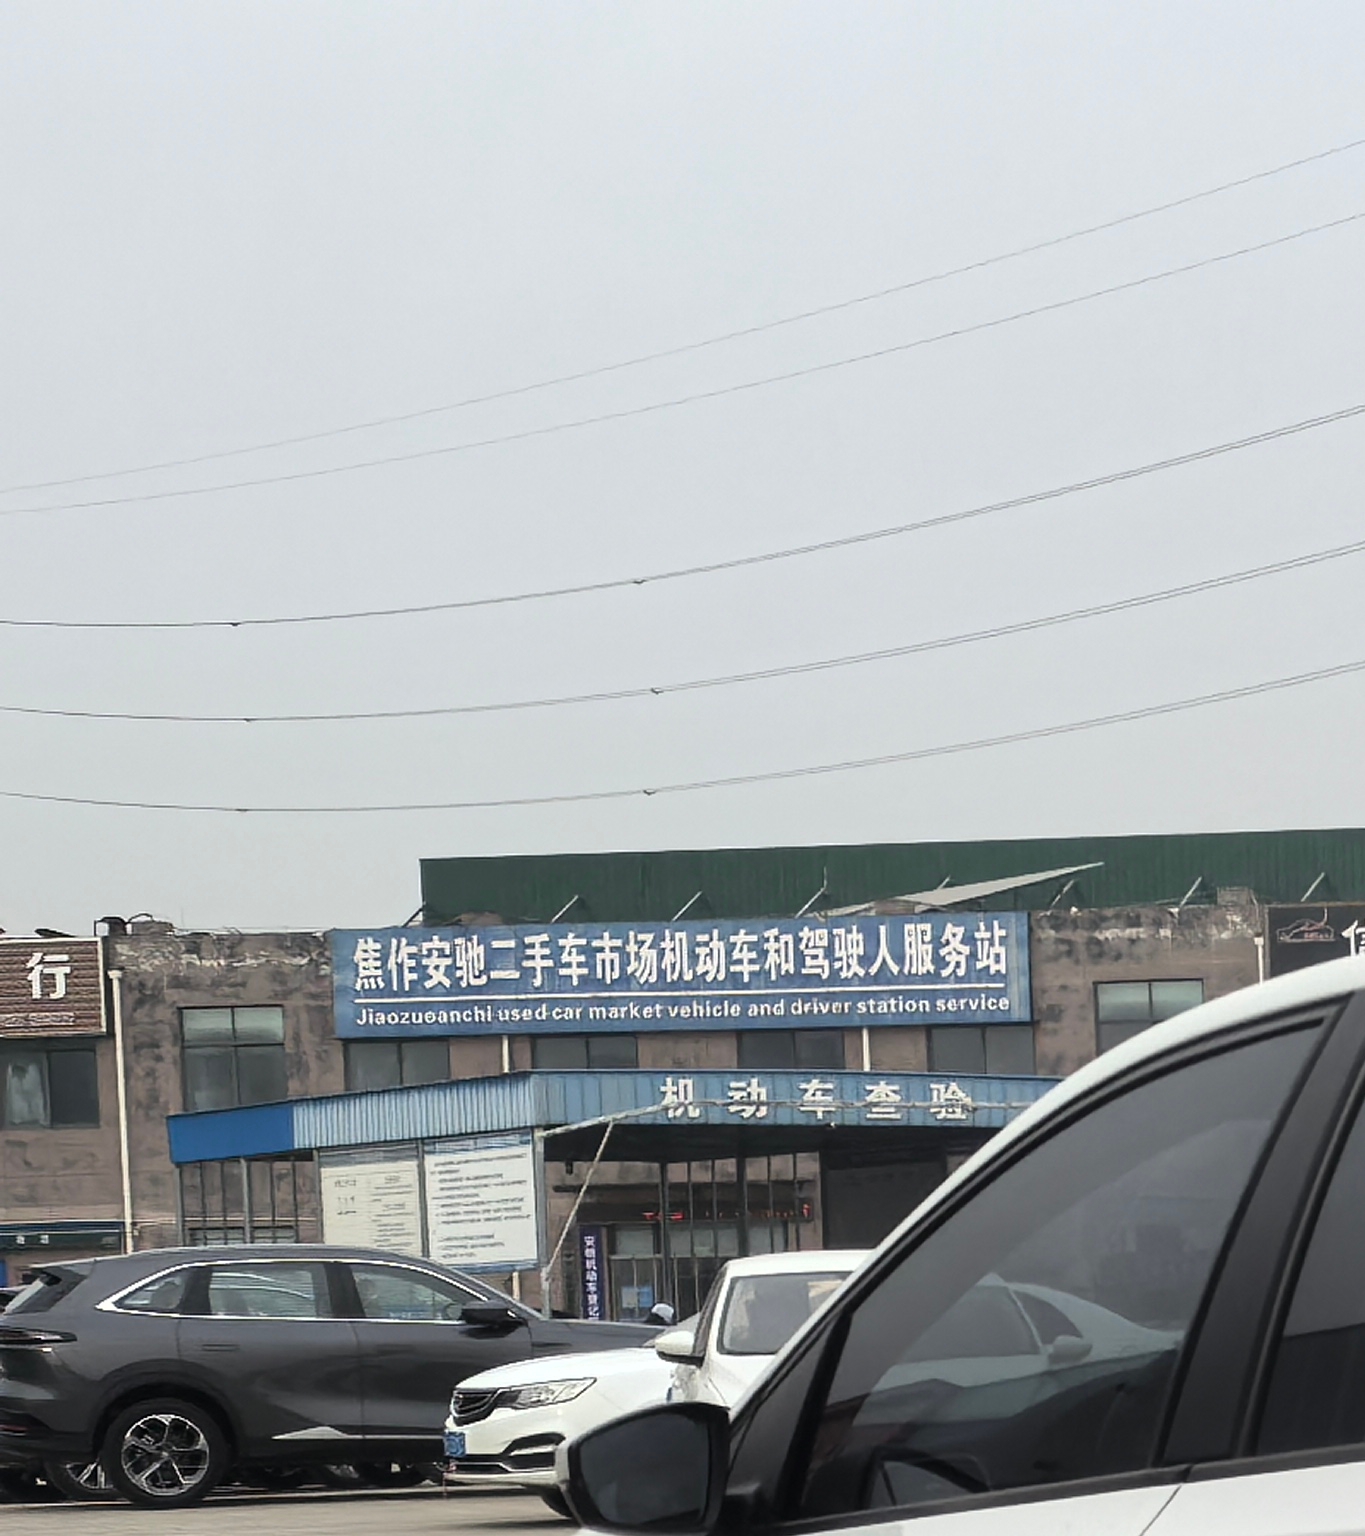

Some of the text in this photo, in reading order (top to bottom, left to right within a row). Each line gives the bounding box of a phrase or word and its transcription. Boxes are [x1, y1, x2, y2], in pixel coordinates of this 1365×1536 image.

[25, 952, 72, 1000] 行
[353, 920, 1008, 992] 焦作安驰二手车市场机动车和驾驶人服务站
[498, 1003, 547, 1023] used
[552, 1004, 584, 1022] car
[588, 1001, 664, 1021] market
[667, 998, 741, 1019] vehicle
[748, 998, 785, 1017] and
[790, 996, 852, 1015] driver
[857, 995, 931, 1014] station
[936, 993, 1010, 1013] service
[659, 1076, 972, 1121] 机动车查验
